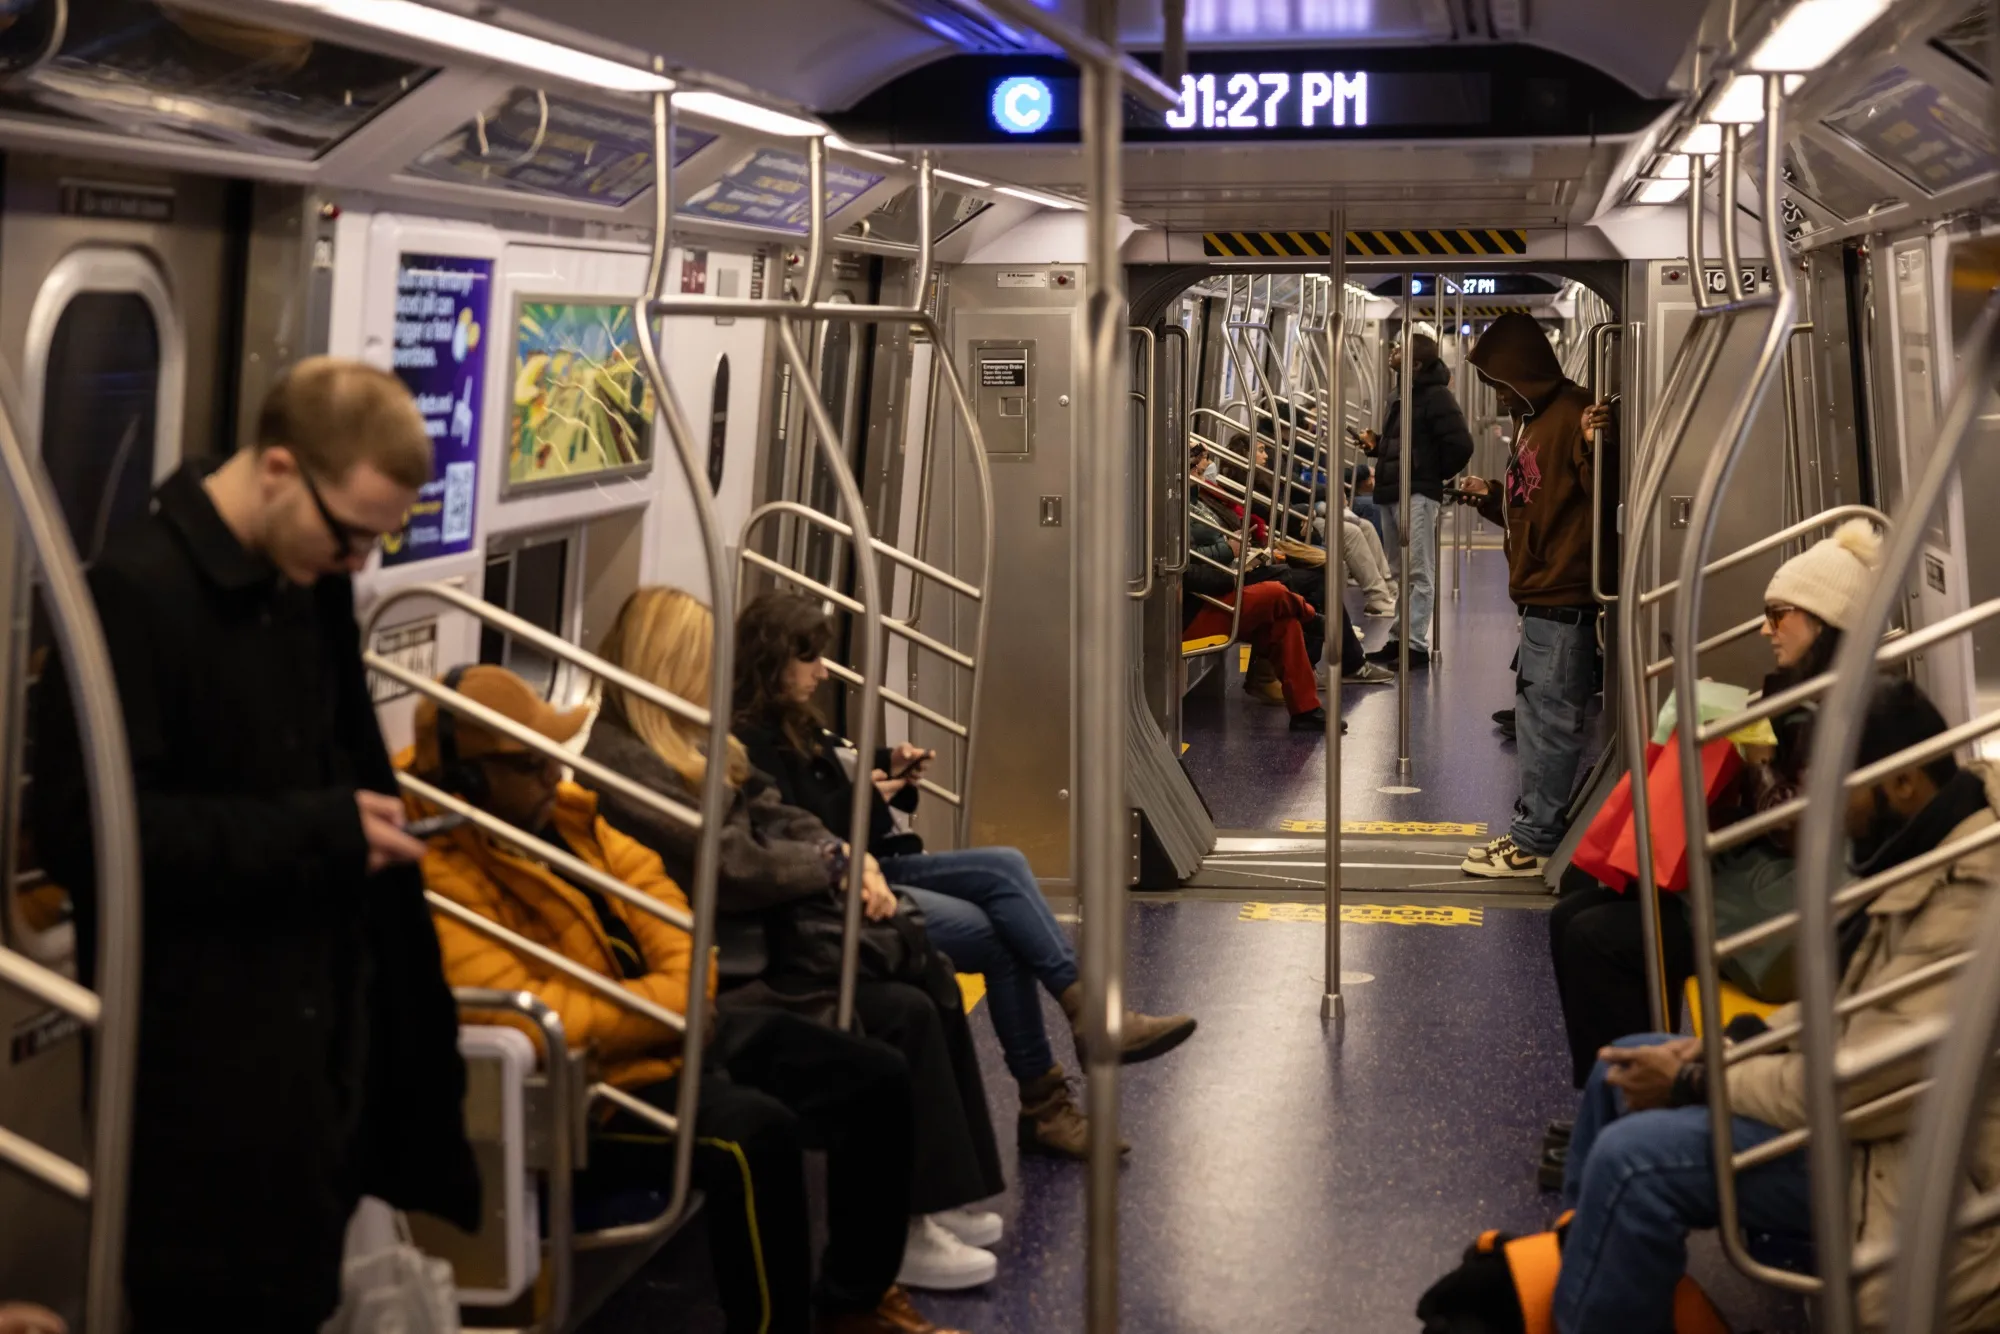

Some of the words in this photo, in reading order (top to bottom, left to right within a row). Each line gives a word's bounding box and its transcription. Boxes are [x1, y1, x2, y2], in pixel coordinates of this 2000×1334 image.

[1004, 84, 1041, 126] C
[1301, 71, 1368, 127] PM
[1478, 279, 1495, 293] PM
[1705, 272, 1754, 291] 402
